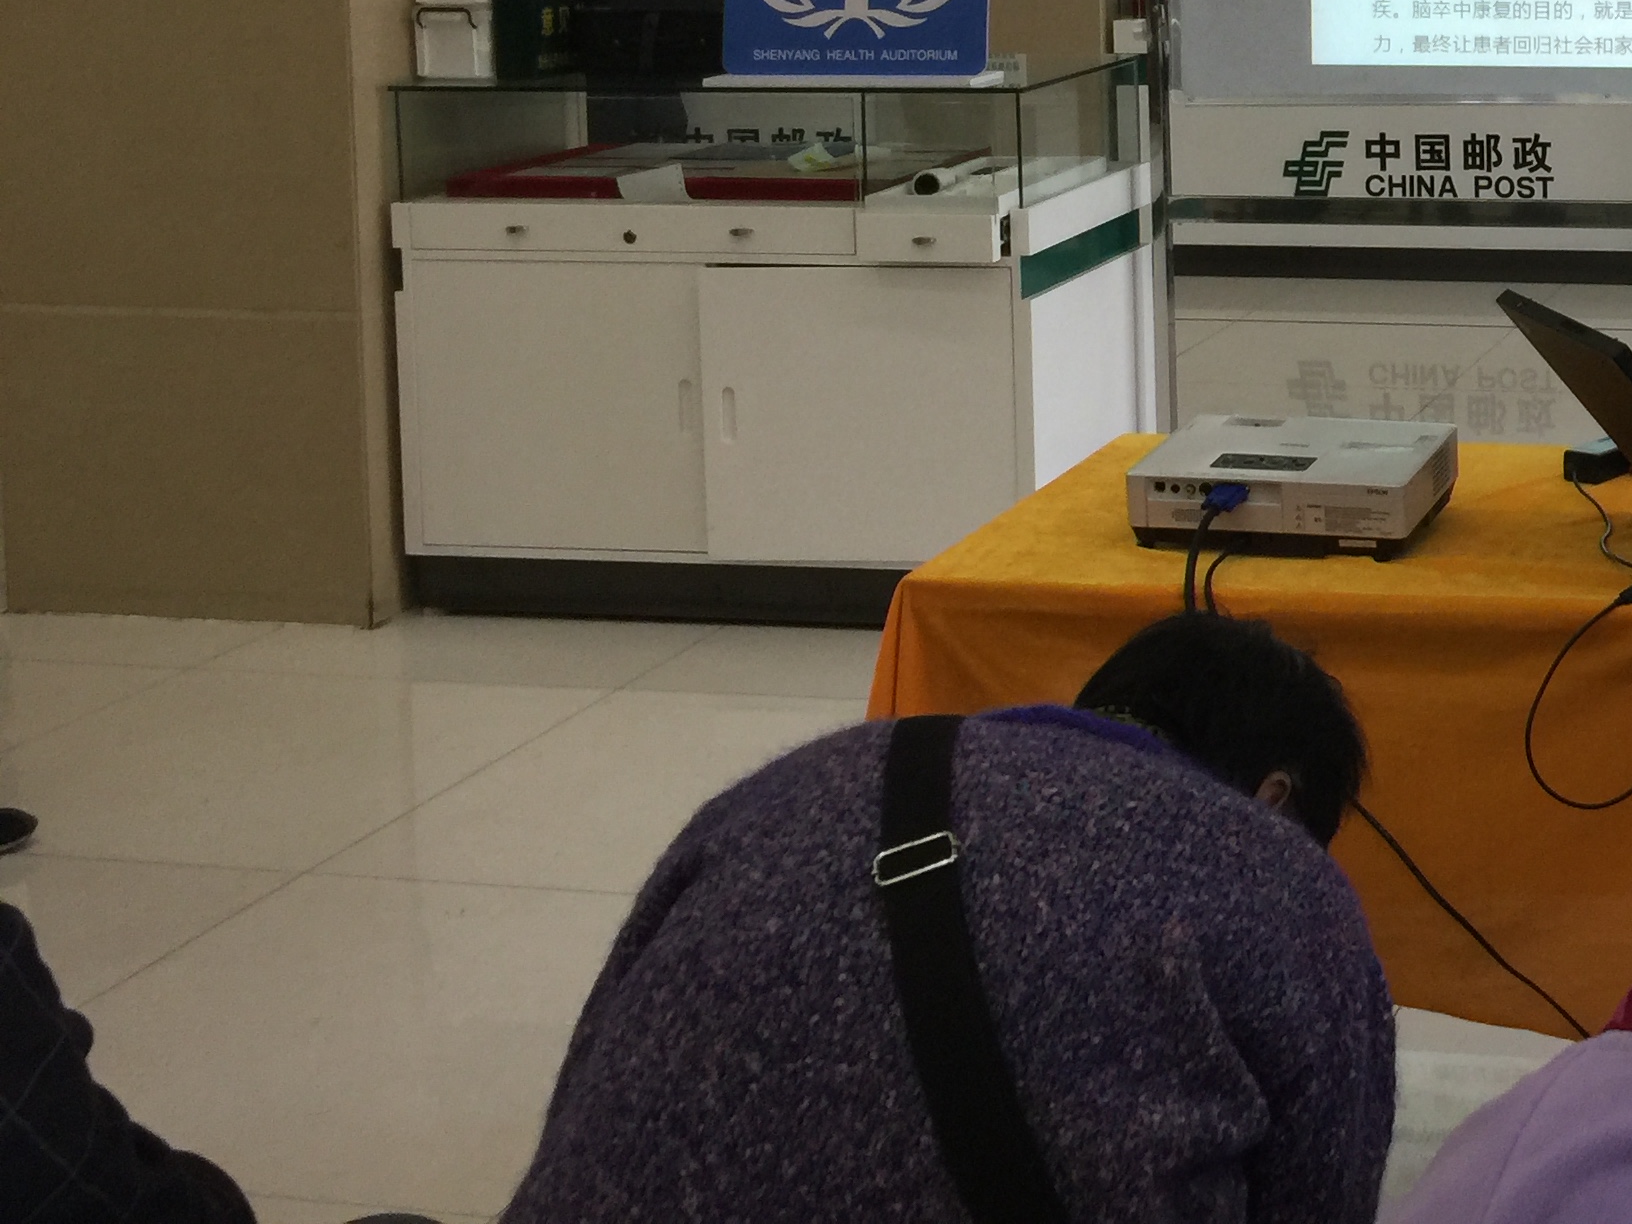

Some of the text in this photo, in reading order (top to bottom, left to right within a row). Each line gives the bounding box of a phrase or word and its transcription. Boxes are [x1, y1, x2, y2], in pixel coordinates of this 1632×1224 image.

[753, 48, 958, 62] SHENYANG HEALTH AUDITORIUM
[1365, 132, 1553, 173] 中国邮政
[1365, 175, 1555, 199] CHINA POST
